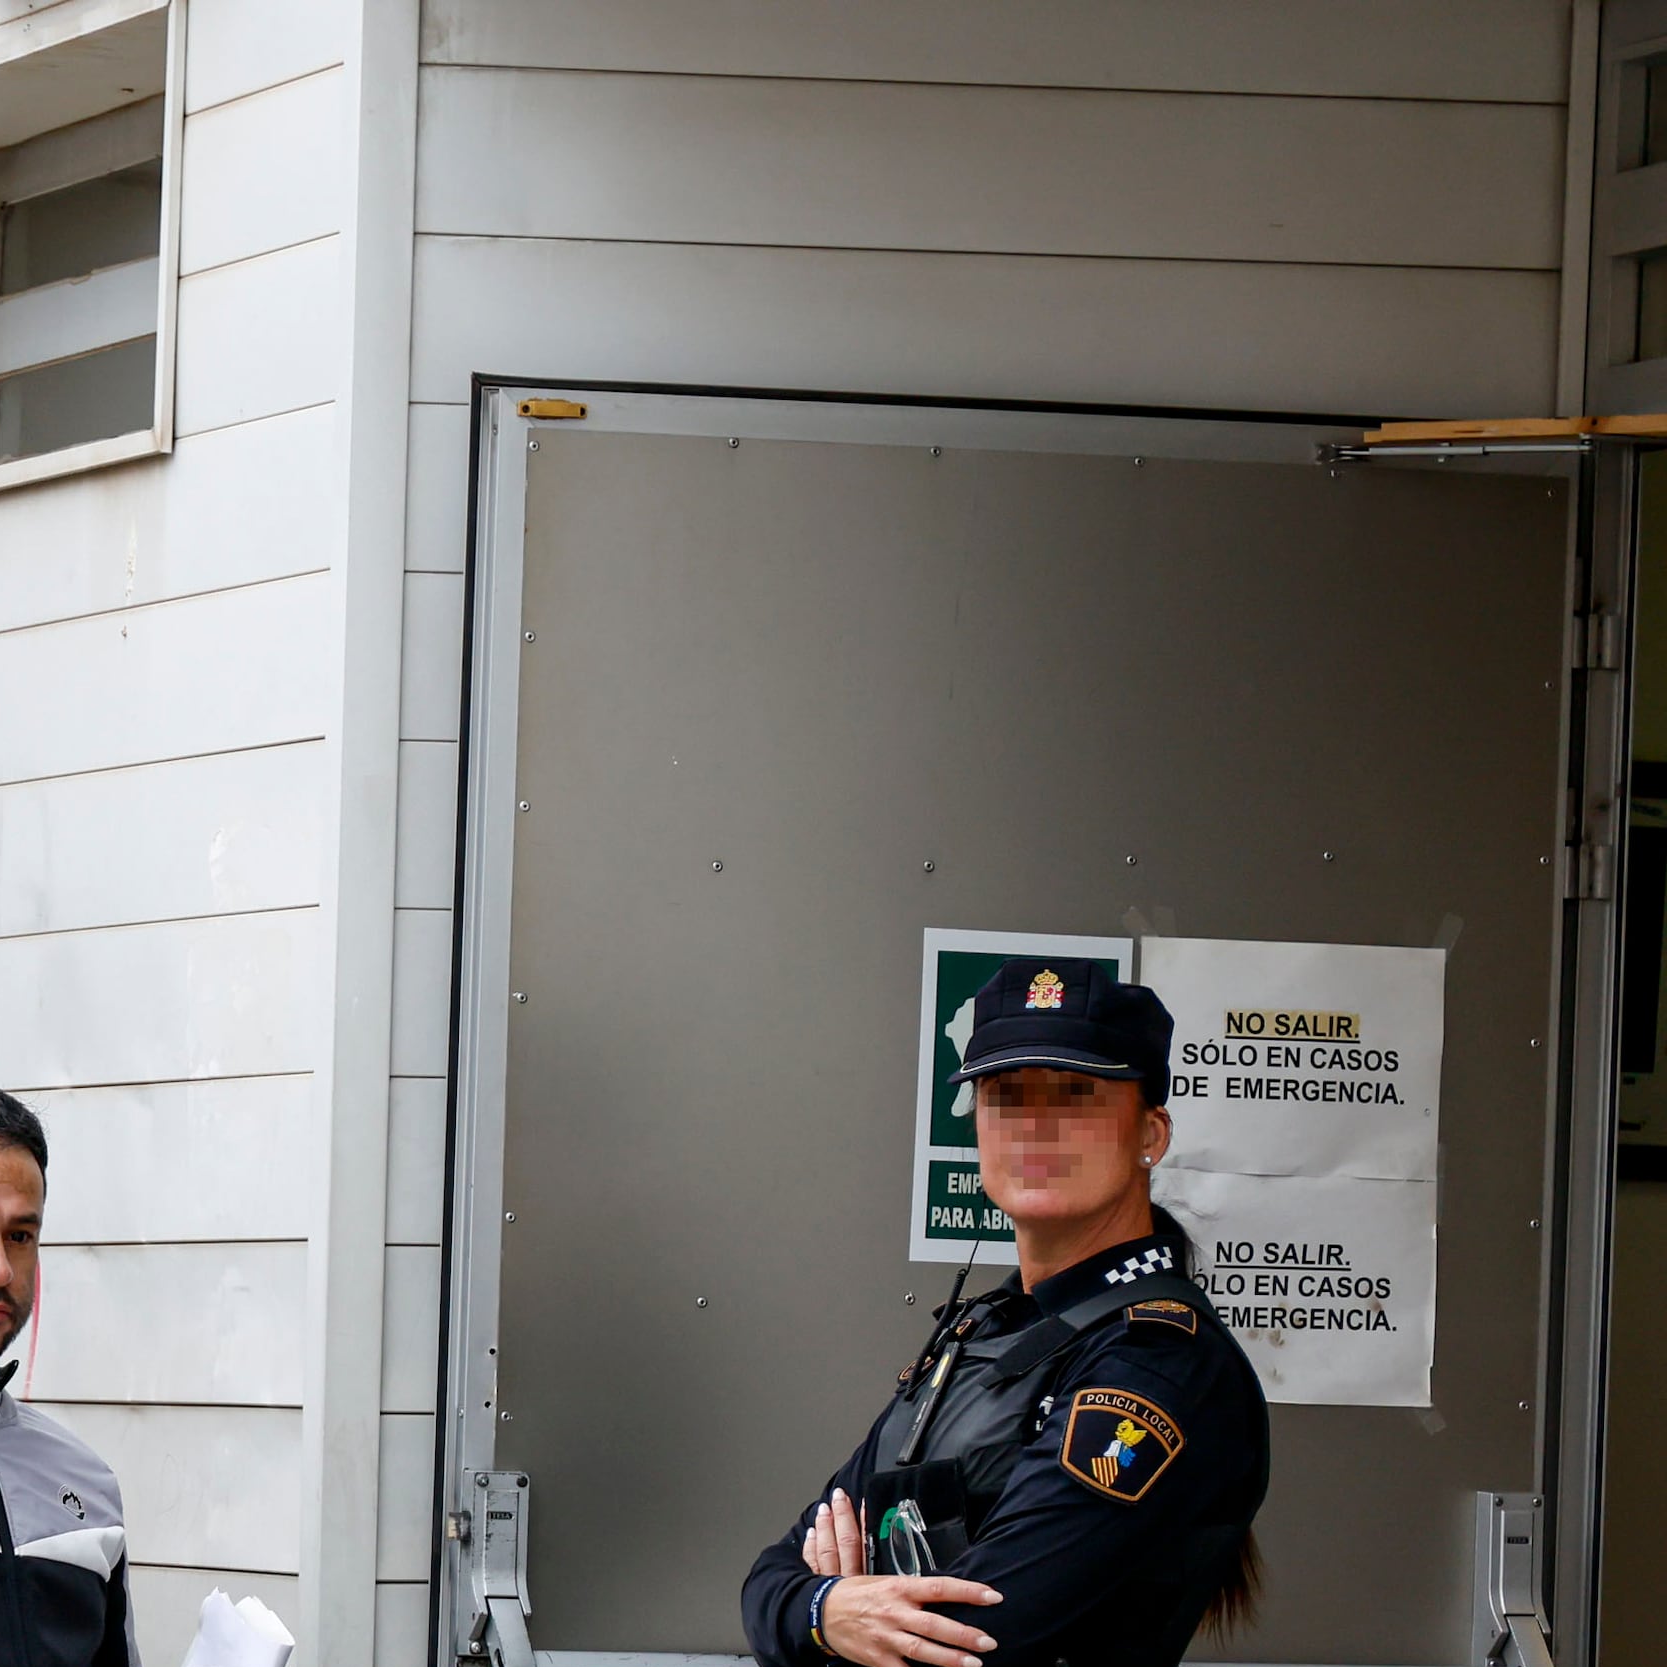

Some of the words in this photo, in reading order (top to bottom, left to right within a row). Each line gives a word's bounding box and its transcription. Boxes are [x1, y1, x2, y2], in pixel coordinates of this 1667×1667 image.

[1226, 1011, 1265, 1035] NO
[1274, 1013, 1359, 1038] SALIR.
[1182, 1039, 1258, 1067] SÓLO
[1266, 1046, 1301, 1068] EN
[1310, 1048, 1399, 1073] CASOS
[1172, 1075, 1208, 1098] DE
[1226, 1077, 1405, 1105] EMERGENCIA.
[947, 1172, 983, 1195] EMP
[930, 1206, 975, 1229] PARA
[979, 1208, 1015, 1231] ABR
[1216, 1241, 1255, 1264] NO
[1263, 1242, 1351, 1266] SALIR.
[1195, 1269, 1246, 1296] ÓLO
[1254, 1275, 1289, 1297] EN
[1298, 1276, 1391, 1299] CASOS
[1216, 1305, 1398, 1332] EMERGENCIA.
[1086, 1393, 1139, 1413] POLICIA
[1142, 1409, 1176, 1444] LOCAL
